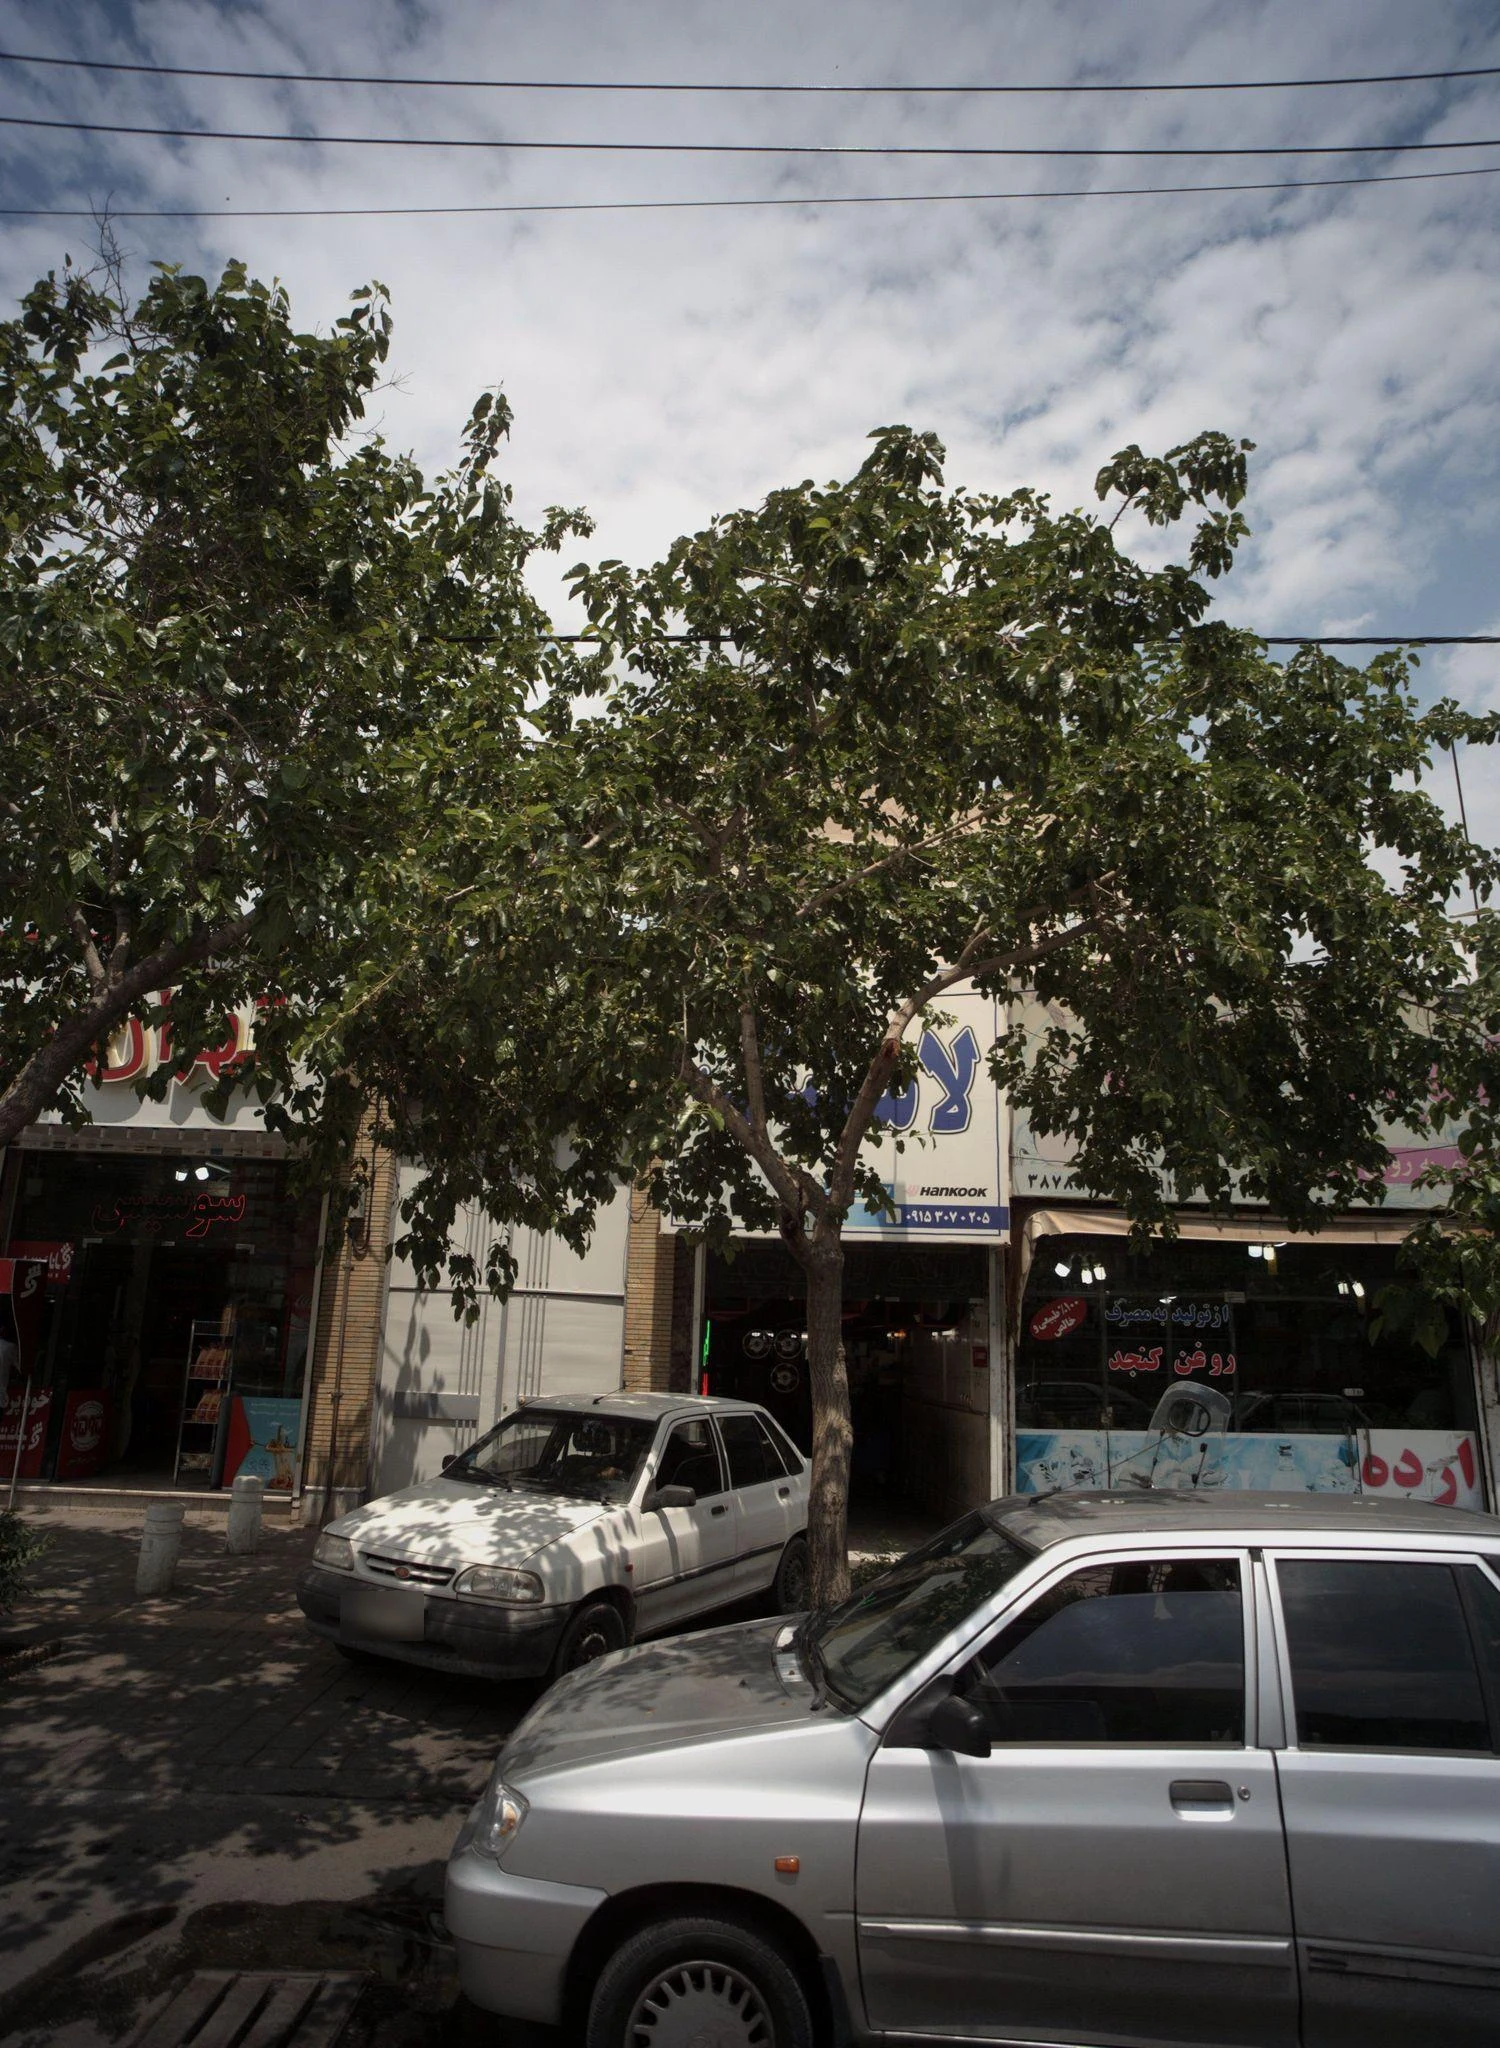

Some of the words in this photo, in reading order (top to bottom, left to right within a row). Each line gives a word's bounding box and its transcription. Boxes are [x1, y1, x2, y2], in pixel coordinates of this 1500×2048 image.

[1104, 1299, 1151, 1328] مصرف
[1153, 1305, 1168, 1327] به
[1171, 1303, 1210, 1328] تولید
[1108, 1345, 1164, 1378] کنجد
[1173, 1340, 1237, 1376] روغن
[1361, 1437, 1475, 1506] ارده
